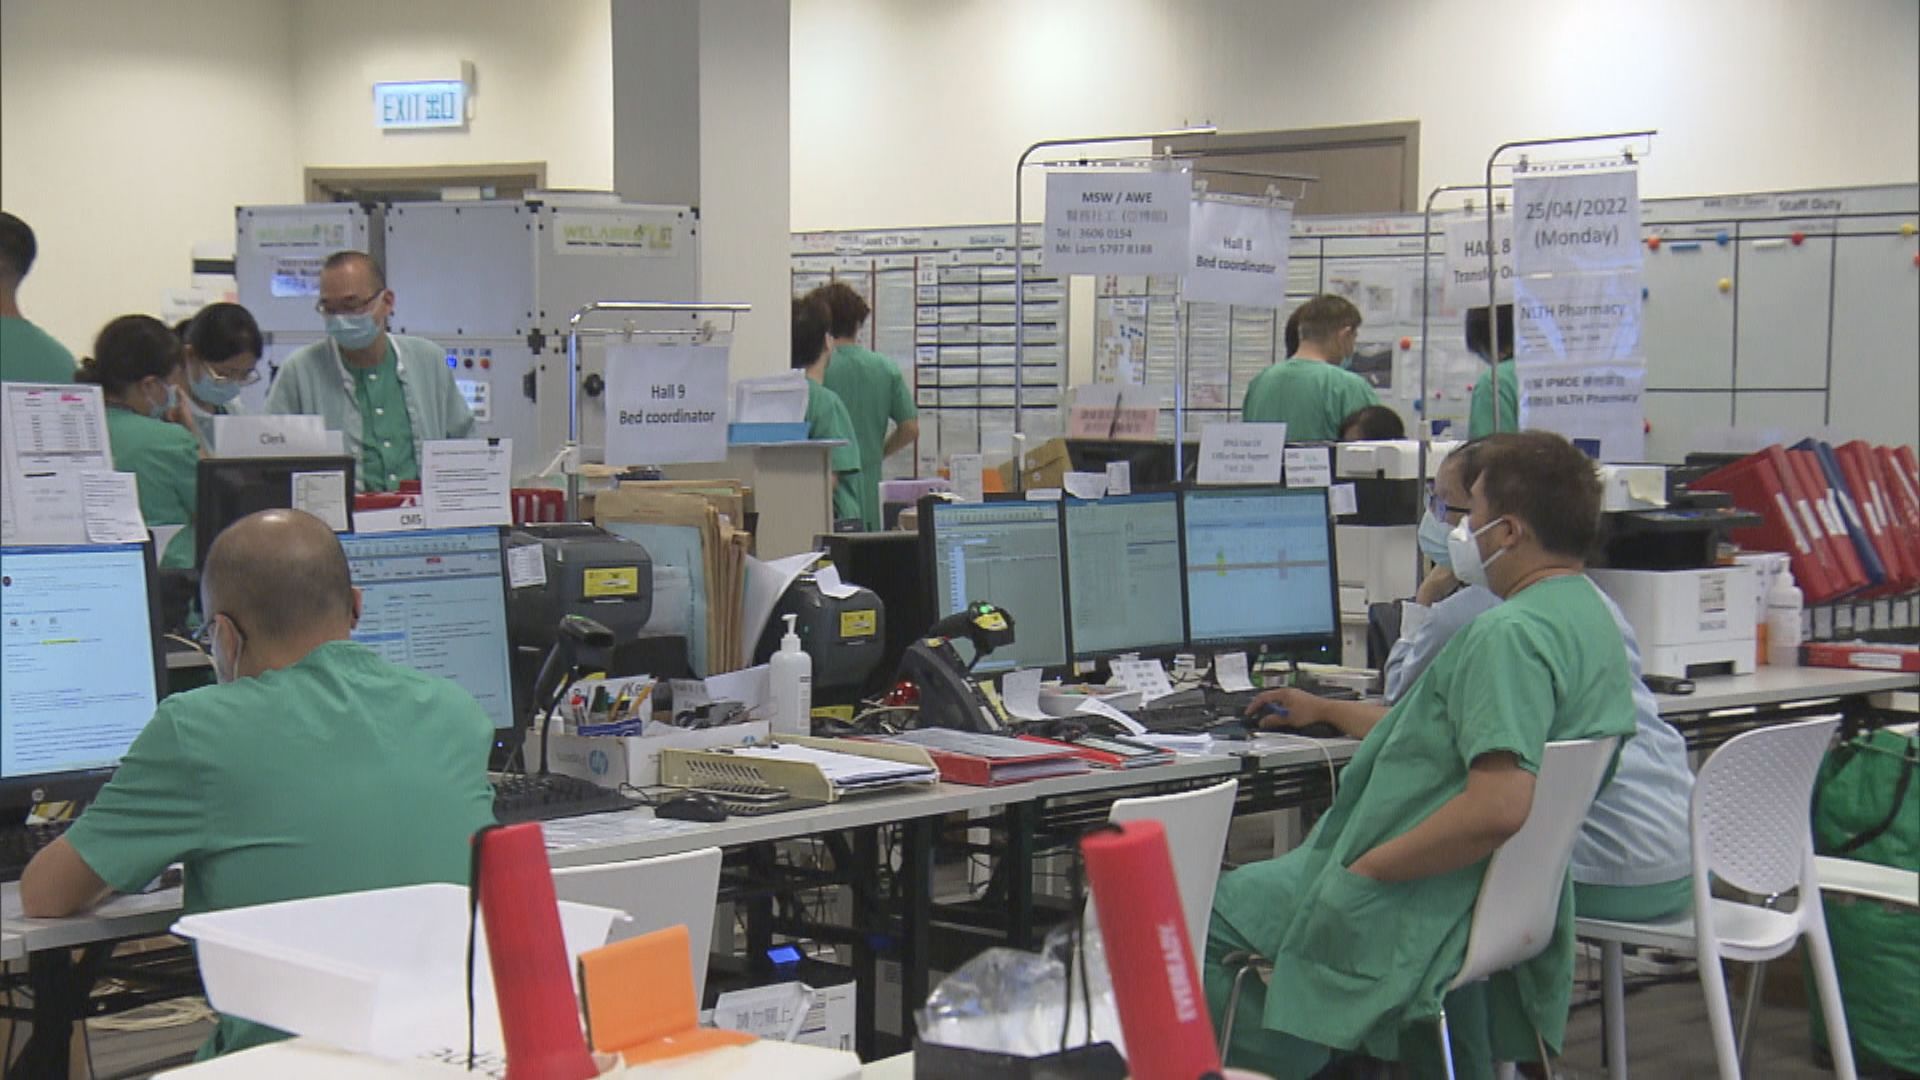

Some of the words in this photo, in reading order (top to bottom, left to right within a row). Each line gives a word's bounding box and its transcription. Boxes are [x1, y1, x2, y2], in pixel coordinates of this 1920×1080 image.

[383, 93, 419, 121] EXIT
[425, 91, 456, 119] 出口
[1081, 192, 1113, 203] MSW
[1125, 192, 1153, 203] AWE
[1525, 197, 1629, 220] 25/04/2022
[1223, 237, 1243, 249] Hall
[1246, 239, 1252, 251] 8
[1534, 225, 1620, 249] (Monday)
[1502, 238, 1511, 255] 8
[1196, 255, 1217, 267] Bed
[1218, 259, 1276, 273] coordinator
[1520, 304, 1555, 320] NLTH
[1558, 303, 1625, 318] Pharmacy
[651, 384, 675, 399] Hall
[677, 384, 686, 399] 9
[1586, 393, 1639, 405] Pharmacy
[619, 409, 643, 425] Bed
[646, 407, 716, 424] coordinator
[260, 433, 287, 446] Clerk
[400, 514, 423, 526] CMS
